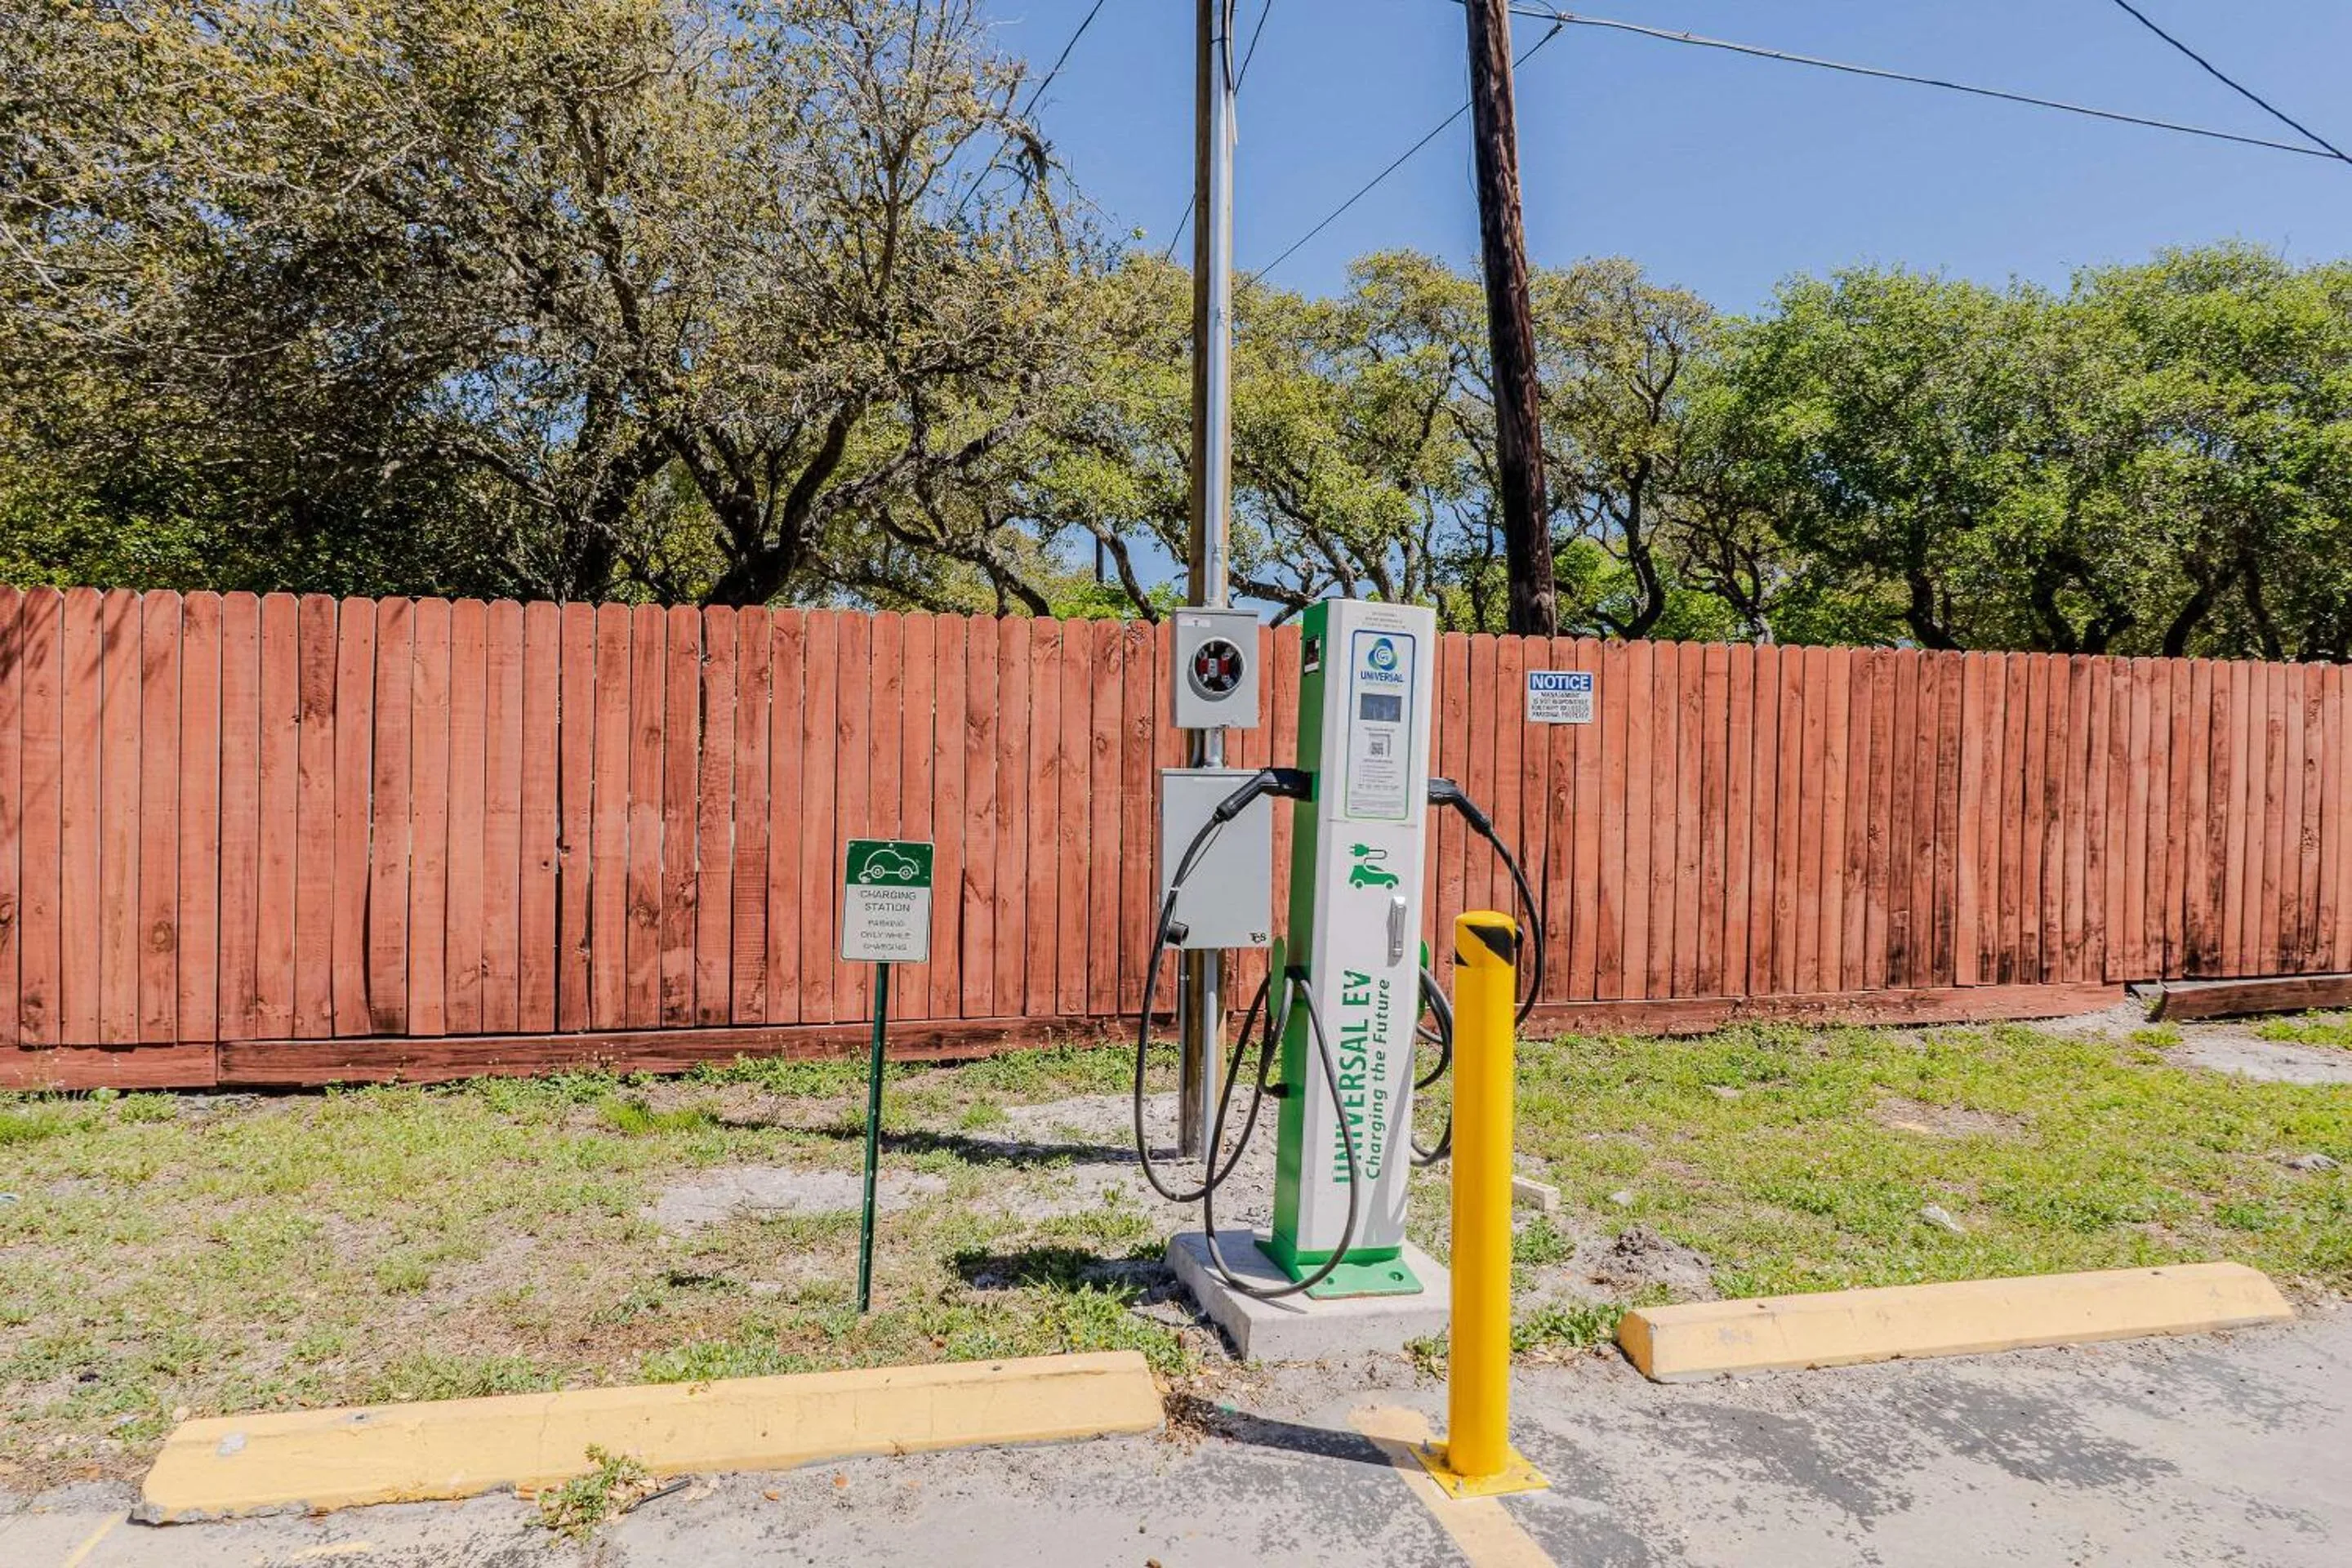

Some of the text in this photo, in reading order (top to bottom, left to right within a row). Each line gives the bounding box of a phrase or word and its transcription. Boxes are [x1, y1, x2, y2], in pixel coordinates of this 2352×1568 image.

[1361, 670, 1404, 683] UNIVERSAL
[1532, 675, 1589, 690] NOTICE
[860, 890, 916, 900] CHARGING
[865, 902, 911, 912] STATION
[860, 930, 883, 938] ONLY
[1333, 969, 1371, 1183] UNIVERSAL EV
[1365, 979, 1390, 1179] Charging the Future
